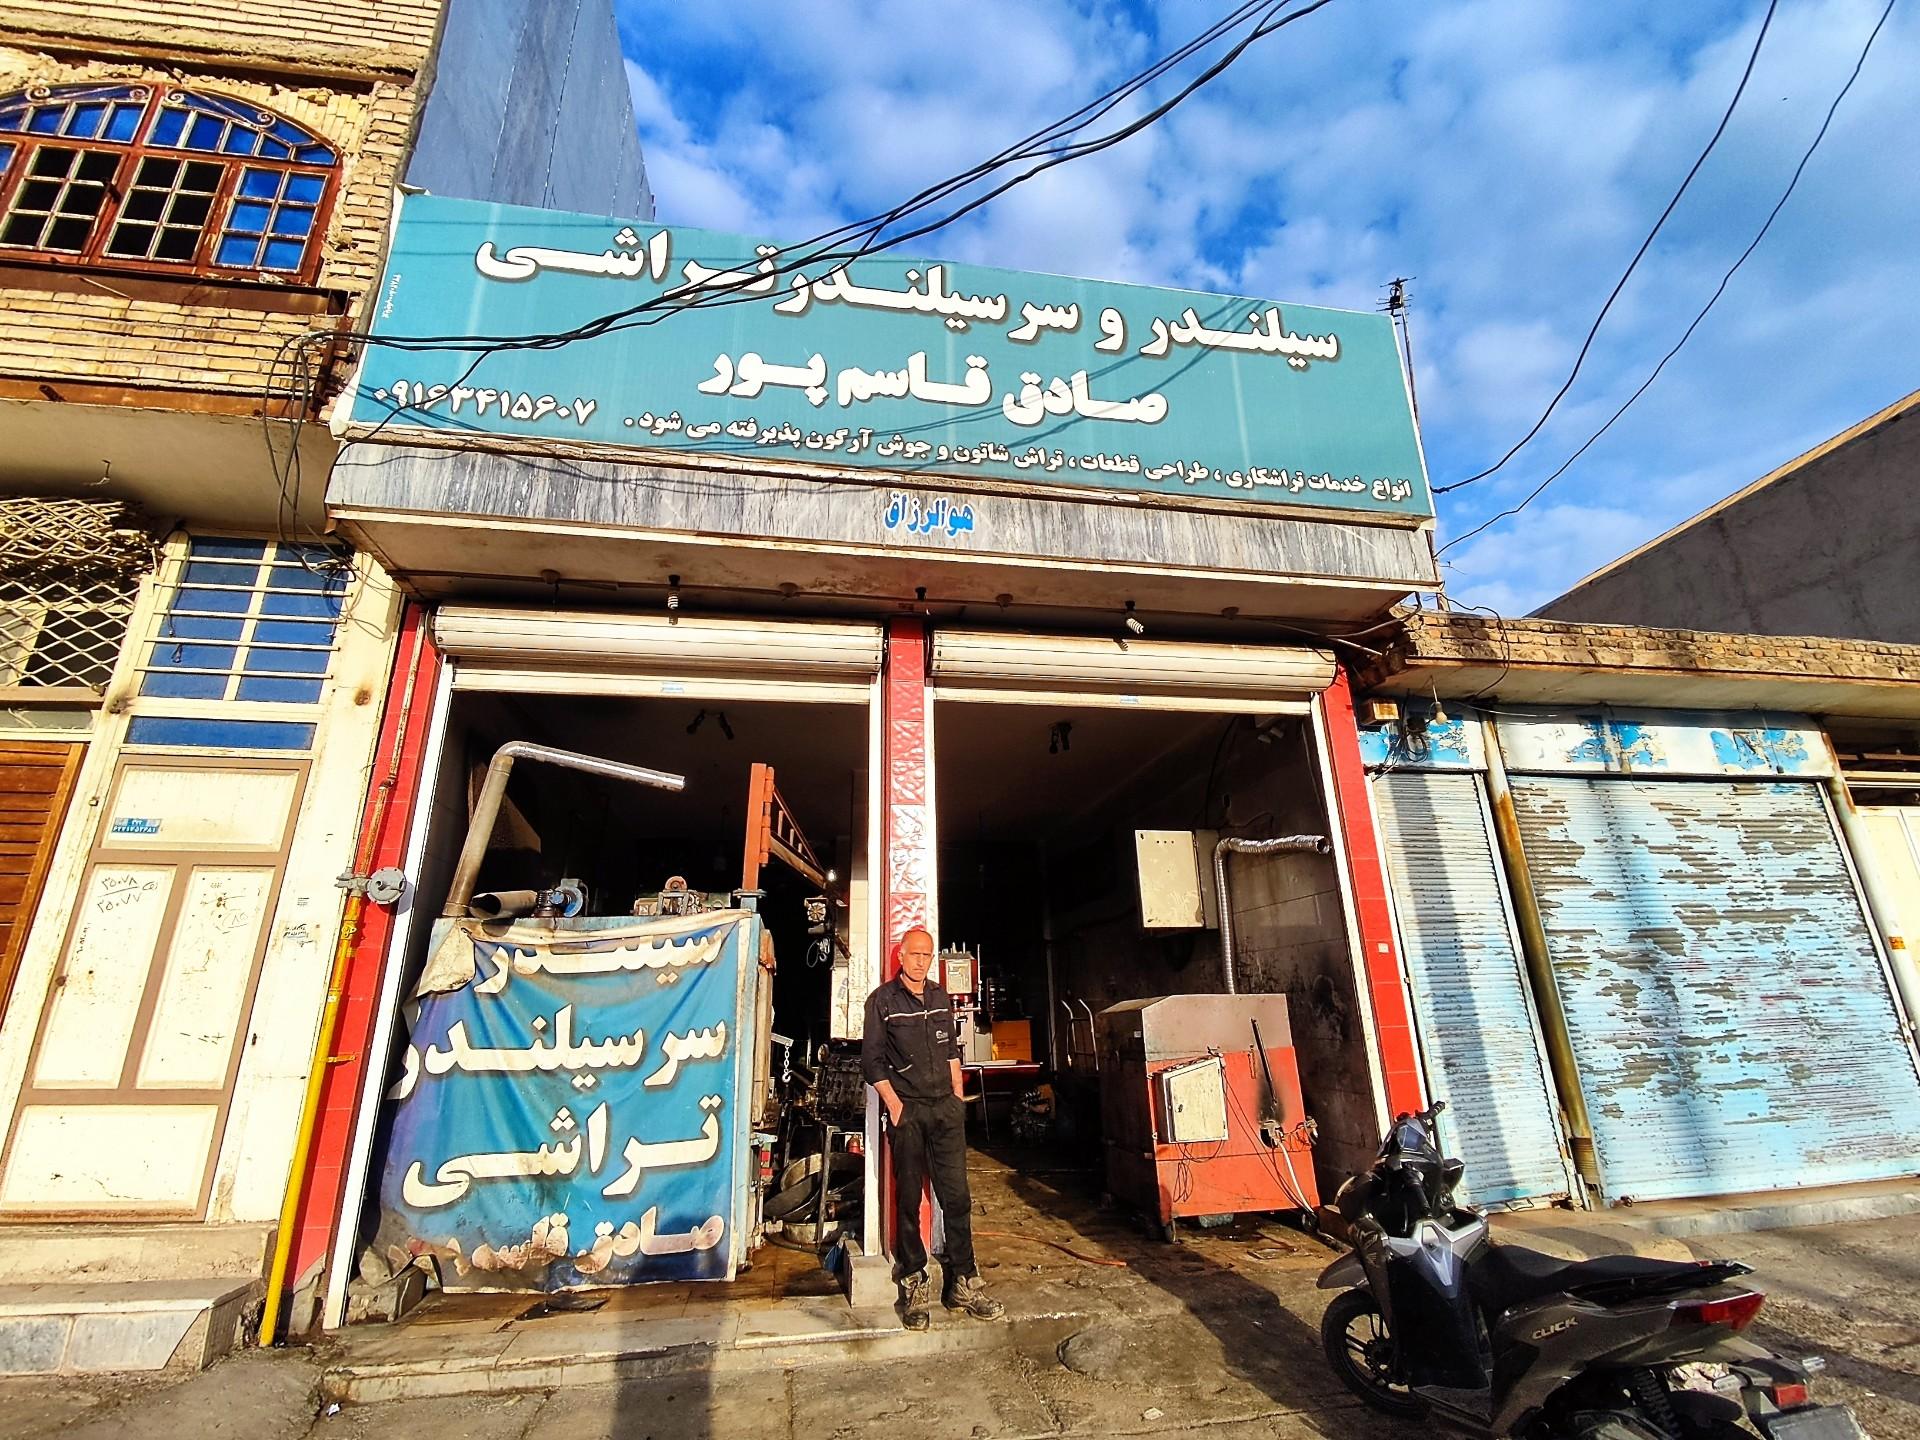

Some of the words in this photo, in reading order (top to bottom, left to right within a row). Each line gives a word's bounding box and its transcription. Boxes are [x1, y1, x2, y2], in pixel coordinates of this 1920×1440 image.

[474, 225, 779, 300] تراشی
[772, 263, 1007, 330] سیلندر
[1006, 301, 1080, 342] سر
[1094, 307, 1125, 352] و
[1138, 306, 1339, 368] سیلندر
[697, 352, 830, 406] پور
[837, 350, 992, 407] قاسم
[1002, 370, 1169, 425] صادق
[685, 420, 721, 438] می
[725, 416, 801, 448] پذیرفته
[804, 428, 873, 454] آرگون
[877, 433, 932, 459] جوش
[936, 444, 949, 461] و
[952, 442, 1009, 464] شاتون
[1013, 447, 1064, 471] تراش
[1144, 459, 1209, 484] طراحی
[1306, 472, 1367, 493] خدمات
[1371, 478, 1412, 501] انواع
[389, 1002, 644, 1100] سیلندر
[643, 1020, 726, 1087] سر
[402, 1094, 721, 1208] تراشی
[574, 1206, 725, 1275] صادق
[1531, 1316, 1579, 1341] CLICK
